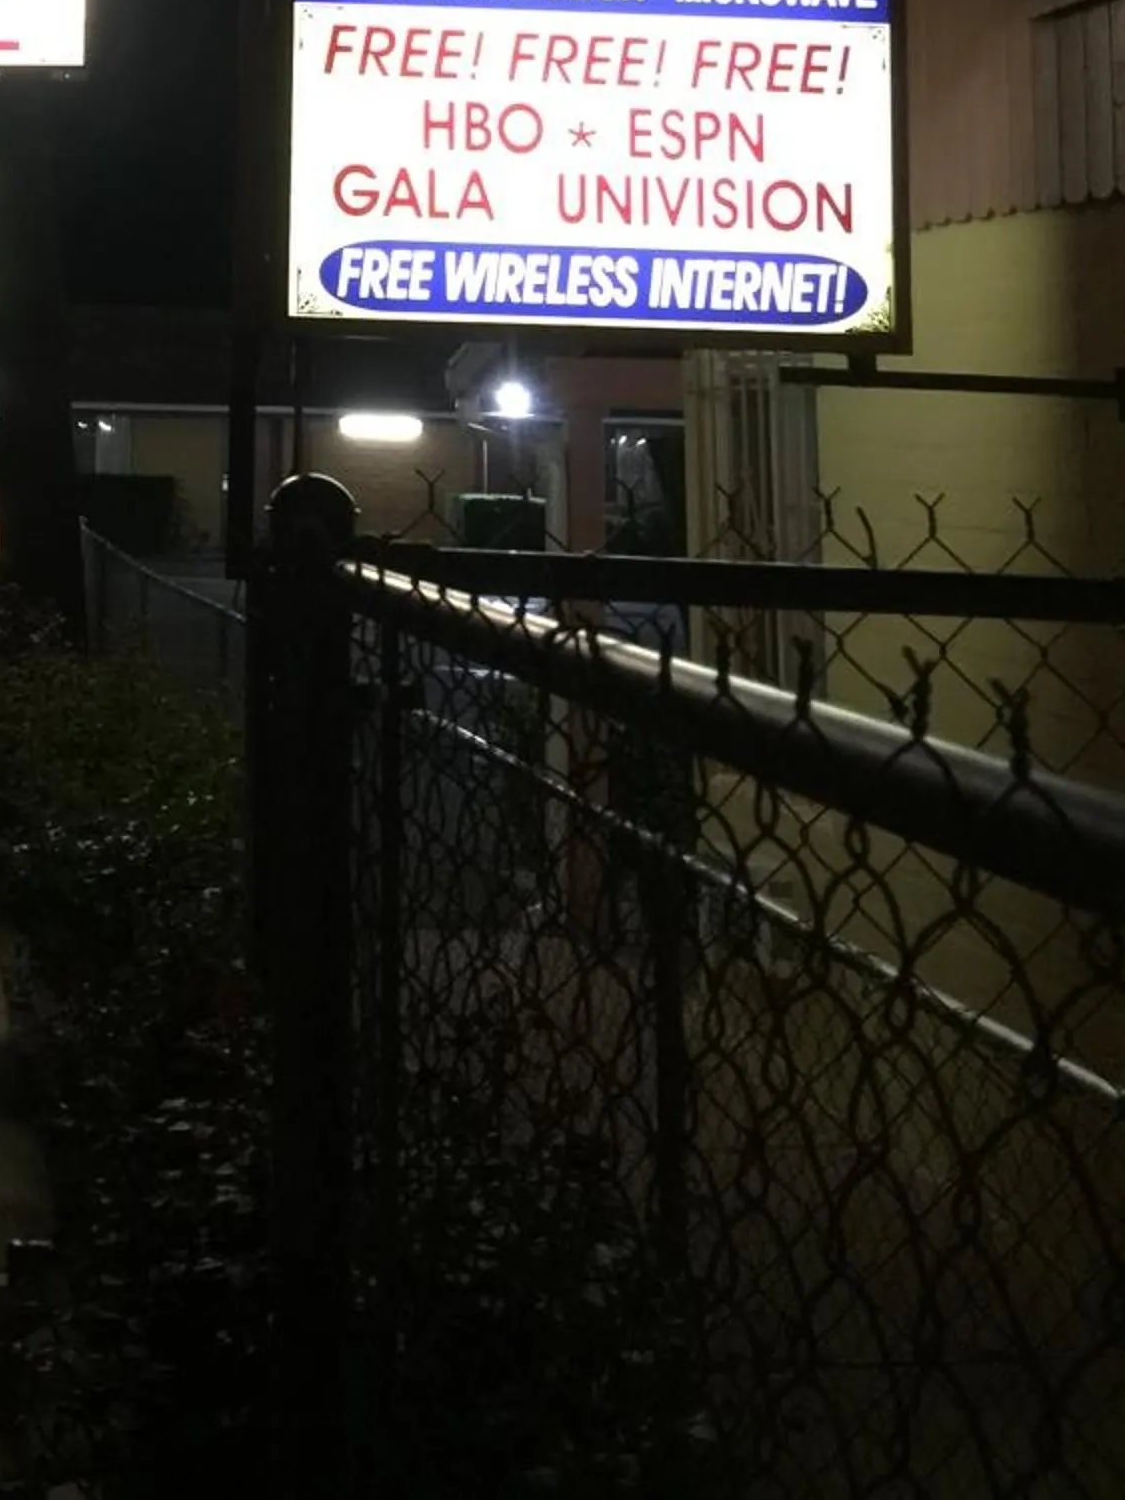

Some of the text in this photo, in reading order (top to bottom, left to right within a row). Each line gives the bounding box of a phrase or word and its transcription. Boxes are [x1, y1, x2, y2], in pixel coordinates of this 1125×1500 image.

[324, 25, 851, 95] FREE! FREE! FREE!
[423, 100, 765, 162] HBO ESPN
[332, 164, 854, 234] GALA UNIVISION
[337, 247, 847, 313] FREE WIRELESS INTERNET!
